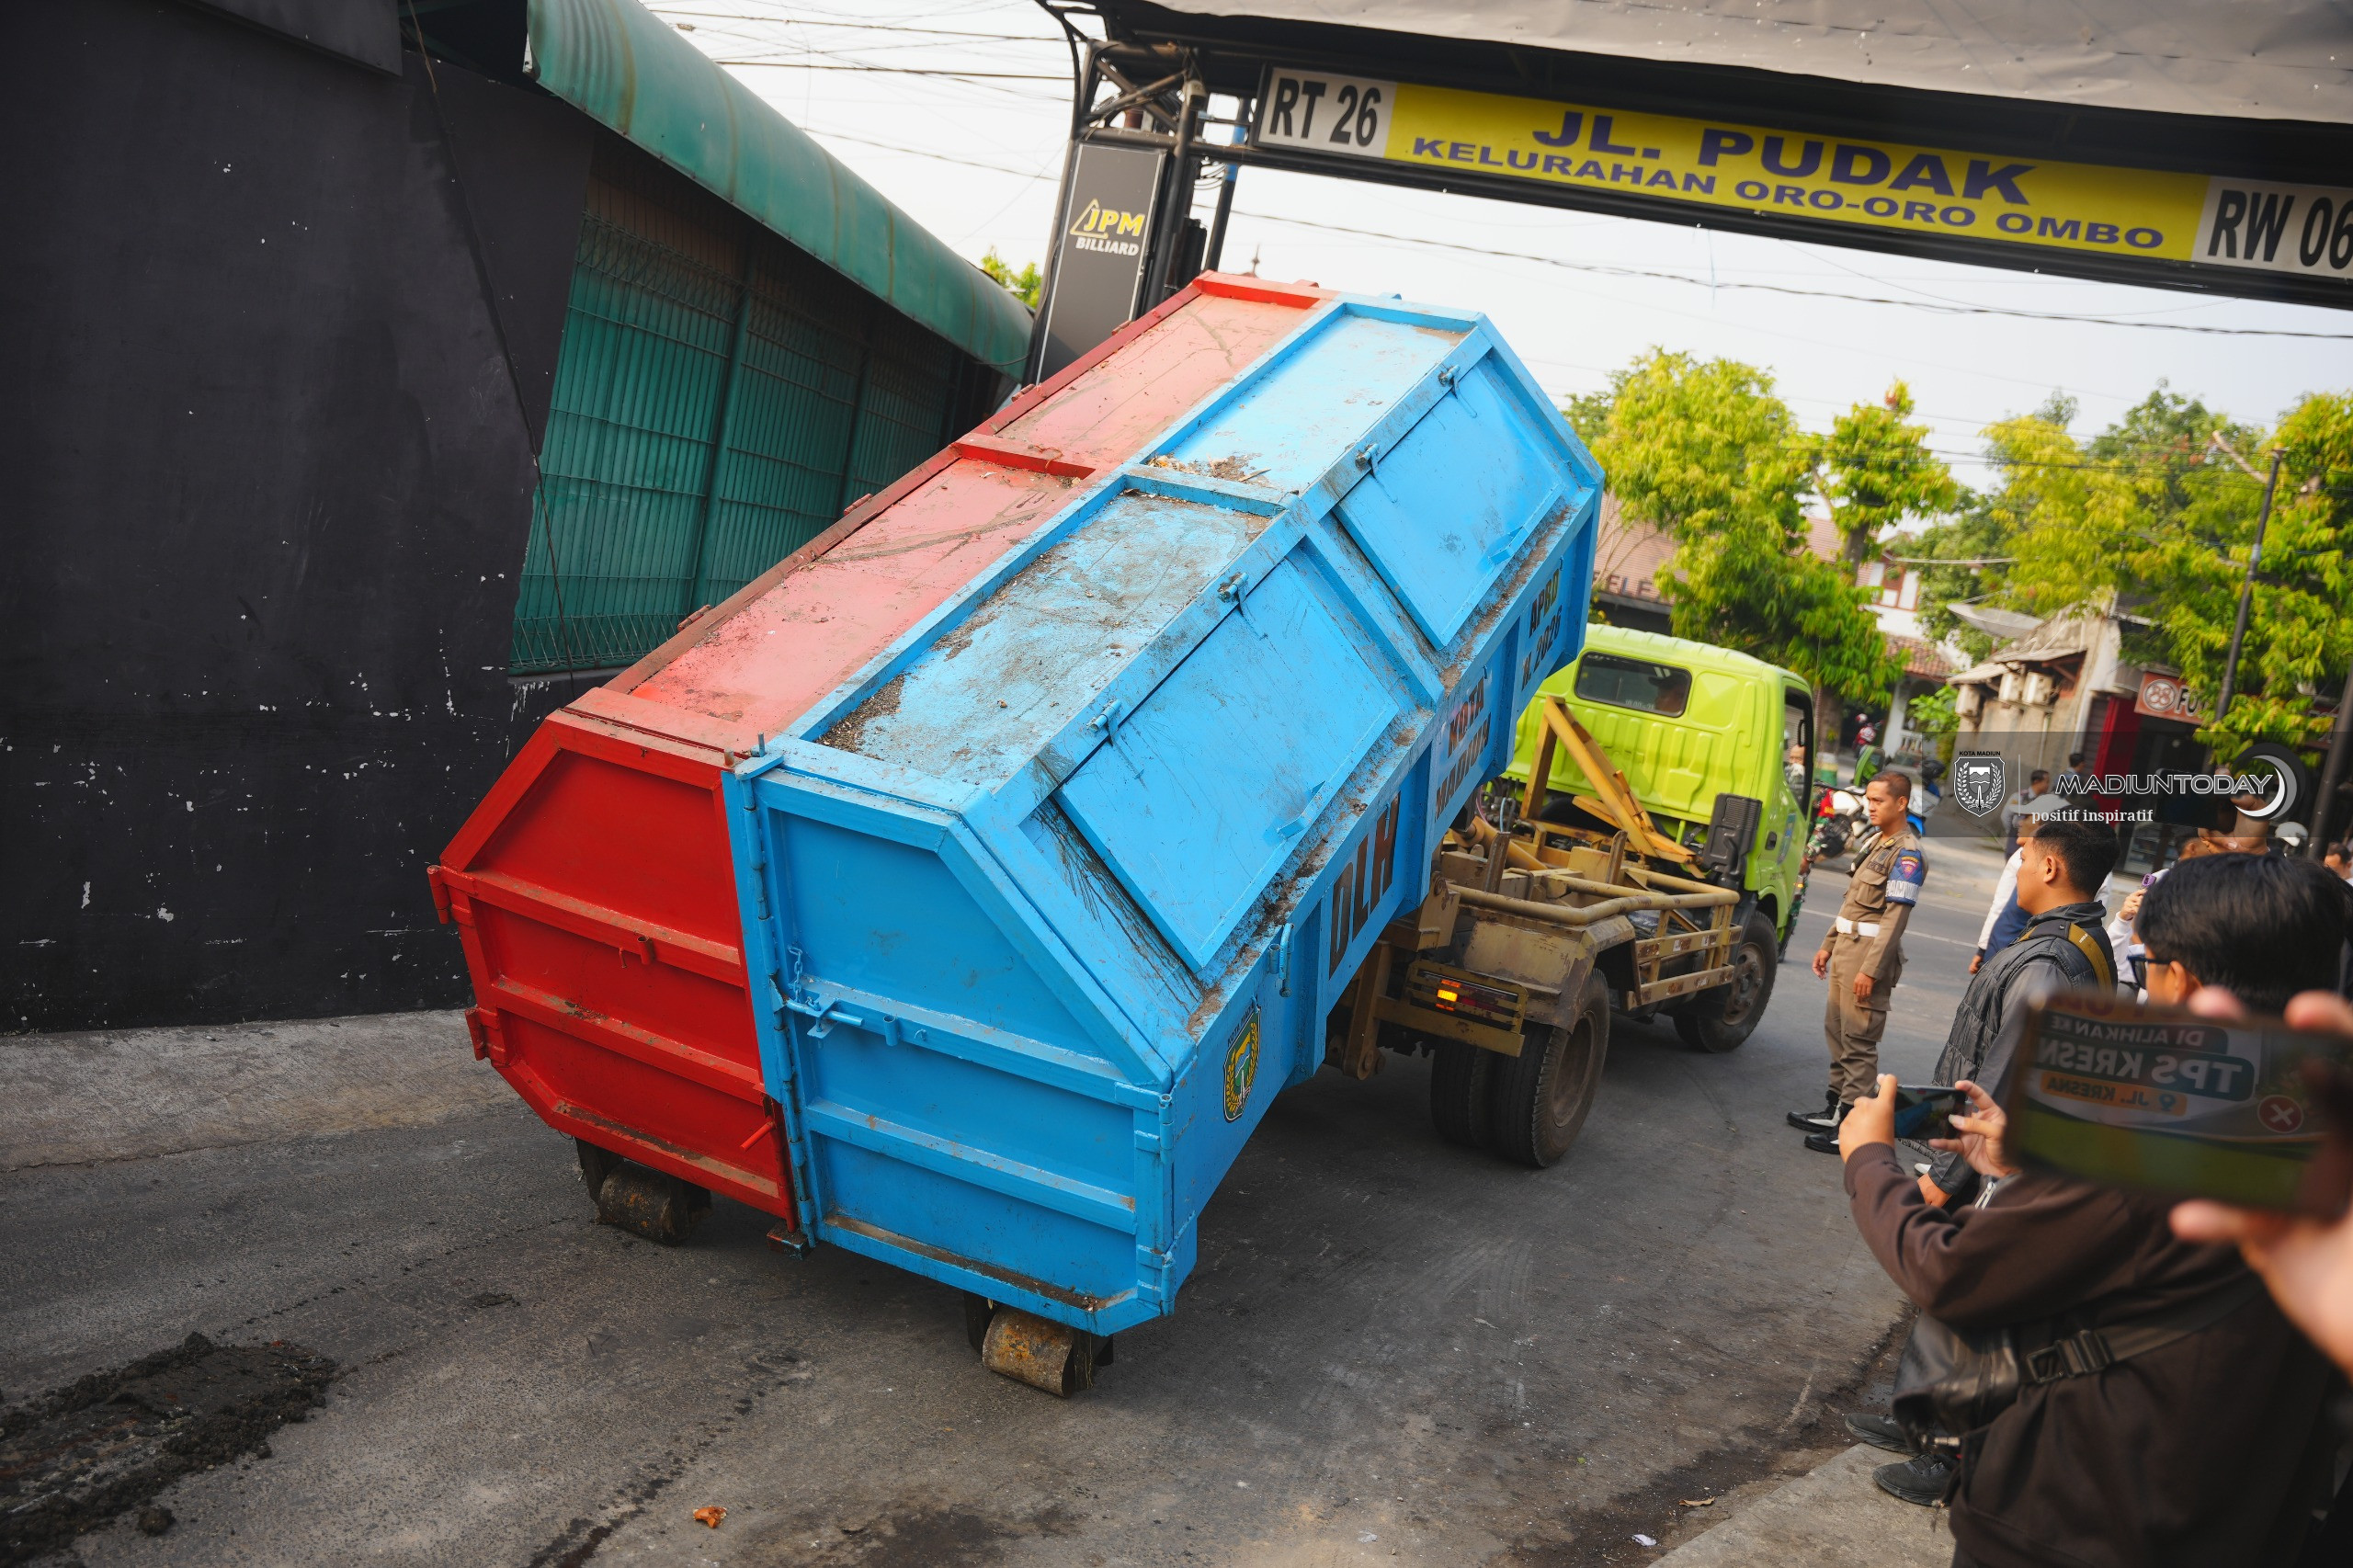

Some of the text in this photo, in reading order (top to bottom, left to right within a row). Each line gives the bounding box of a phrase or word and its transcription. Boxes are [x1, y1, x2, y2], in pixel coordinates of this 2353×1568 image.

[1269, 77, 1381, 147] RT 26
[1412, 138, 2164, 249] KELURAHAN ORO-ORO OMBO
[1532, 111, 2037, 206] JL. PUDAK
[1075, 236, 1140, 256] BILLIARD
[1083, 208, 1145, 237] JPM
[2208, 189, 2353, 270] RW 06
[1448, 675, 1484, 759] KOTA
[1434, 711, 1492, 824] MADIUN
[1329, 790, 1401, 981] DLH
